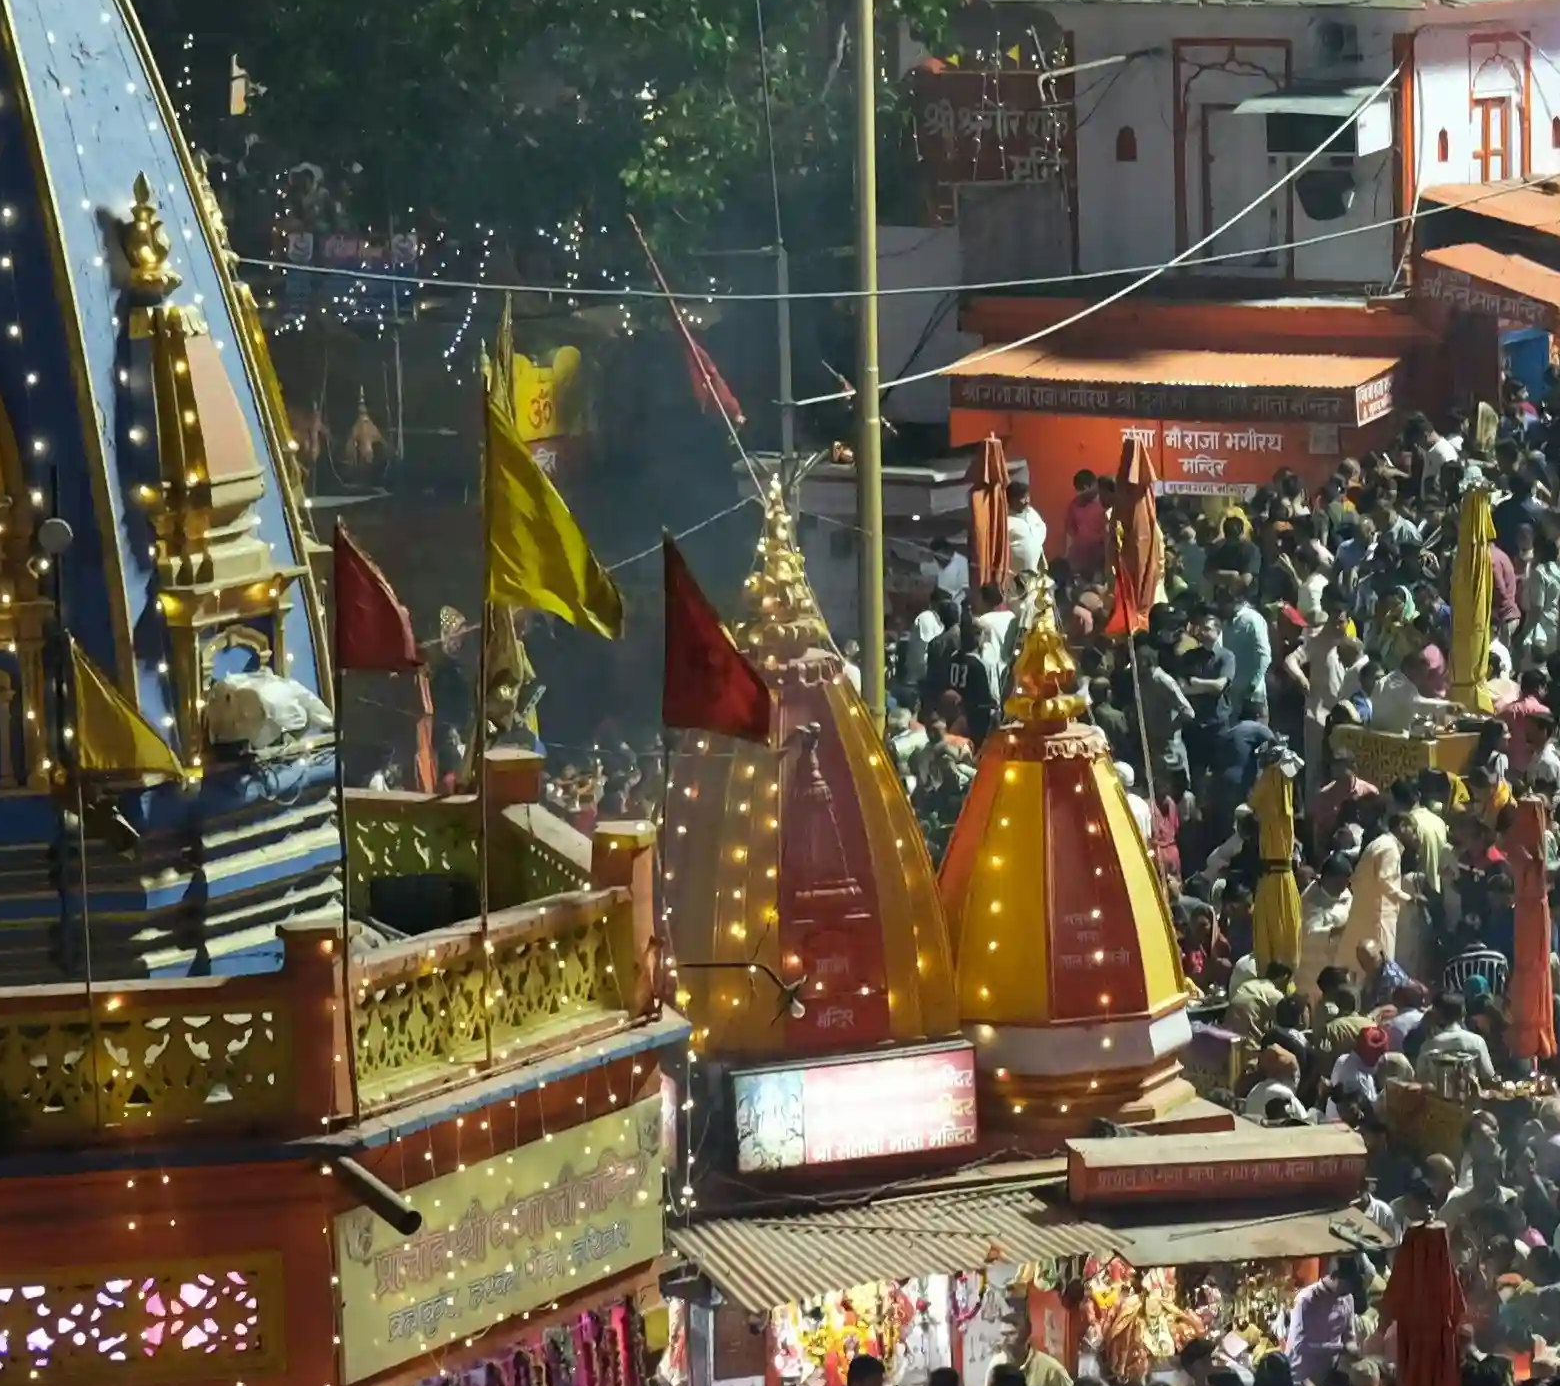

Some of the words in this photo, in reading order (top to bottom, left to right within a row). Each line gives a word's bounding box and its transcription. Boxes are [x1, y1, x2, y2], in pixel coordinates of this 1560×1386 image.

[1182, 430, 1221, 451] राजा
[1223, 427, 1285, 454] भगीरथ
[1177, 453, 1229, 478] मन्दिर
